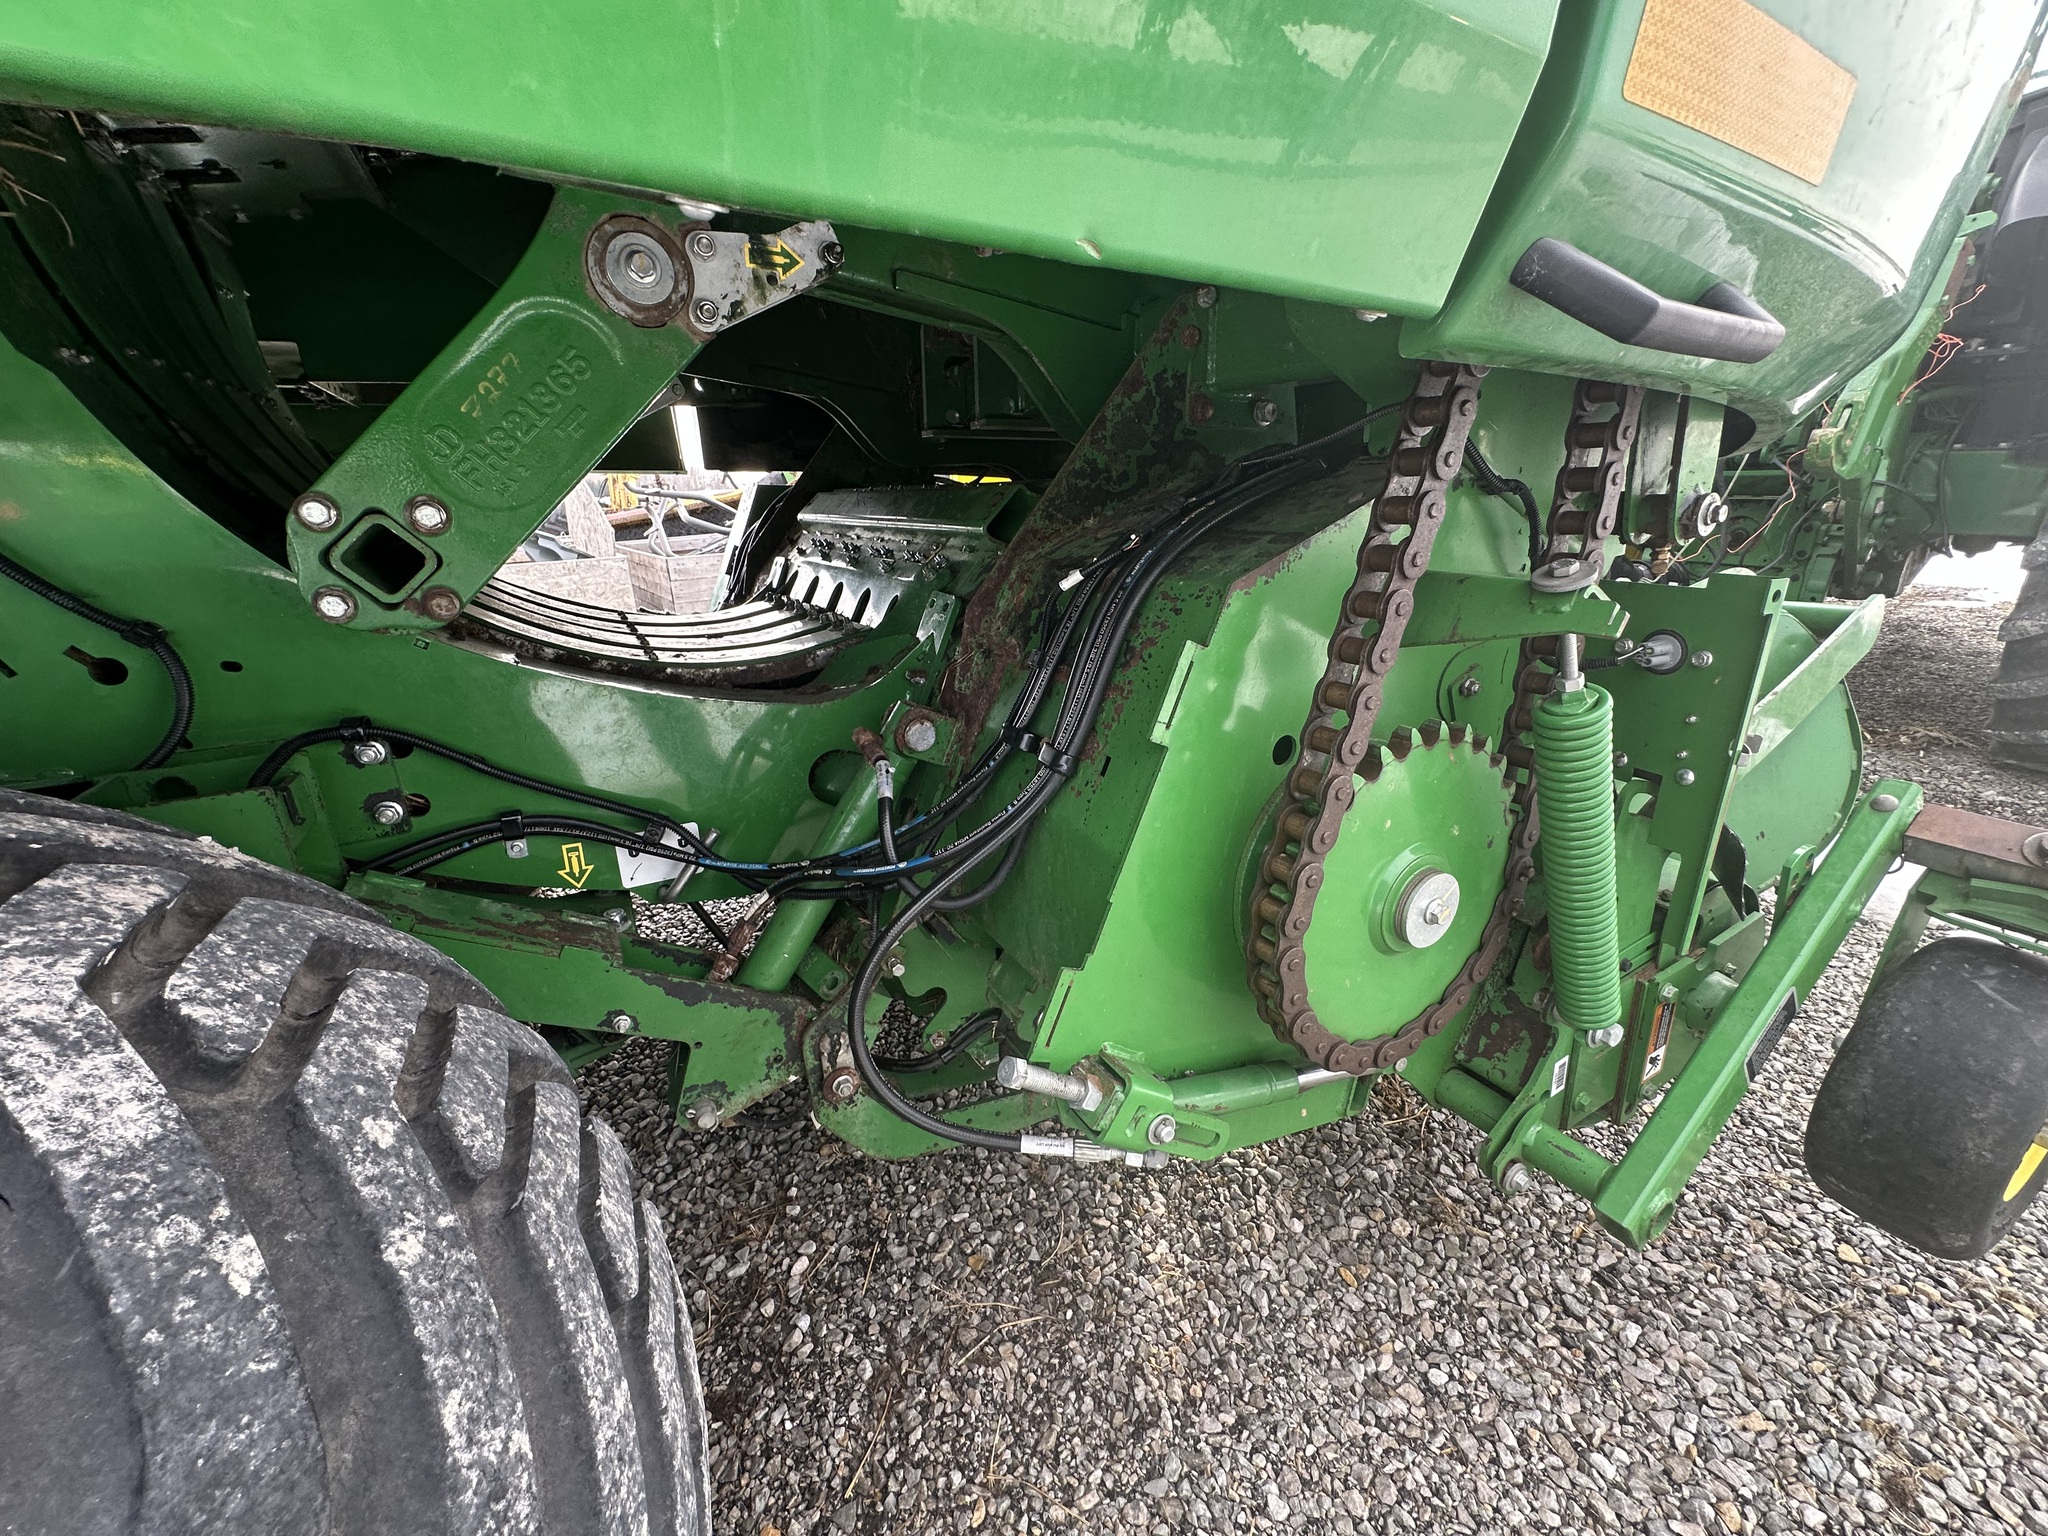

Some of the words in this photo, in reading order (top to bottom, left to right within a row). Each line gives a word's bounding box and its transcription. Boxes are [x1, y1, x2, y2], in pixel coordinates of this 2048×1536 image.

[451, 345, 593, 492] FH321365
[990, 809, 1007, 823] Flame
[968, 820, 992, 837] Resistant
[954, 835, 969, 846] MSHA
